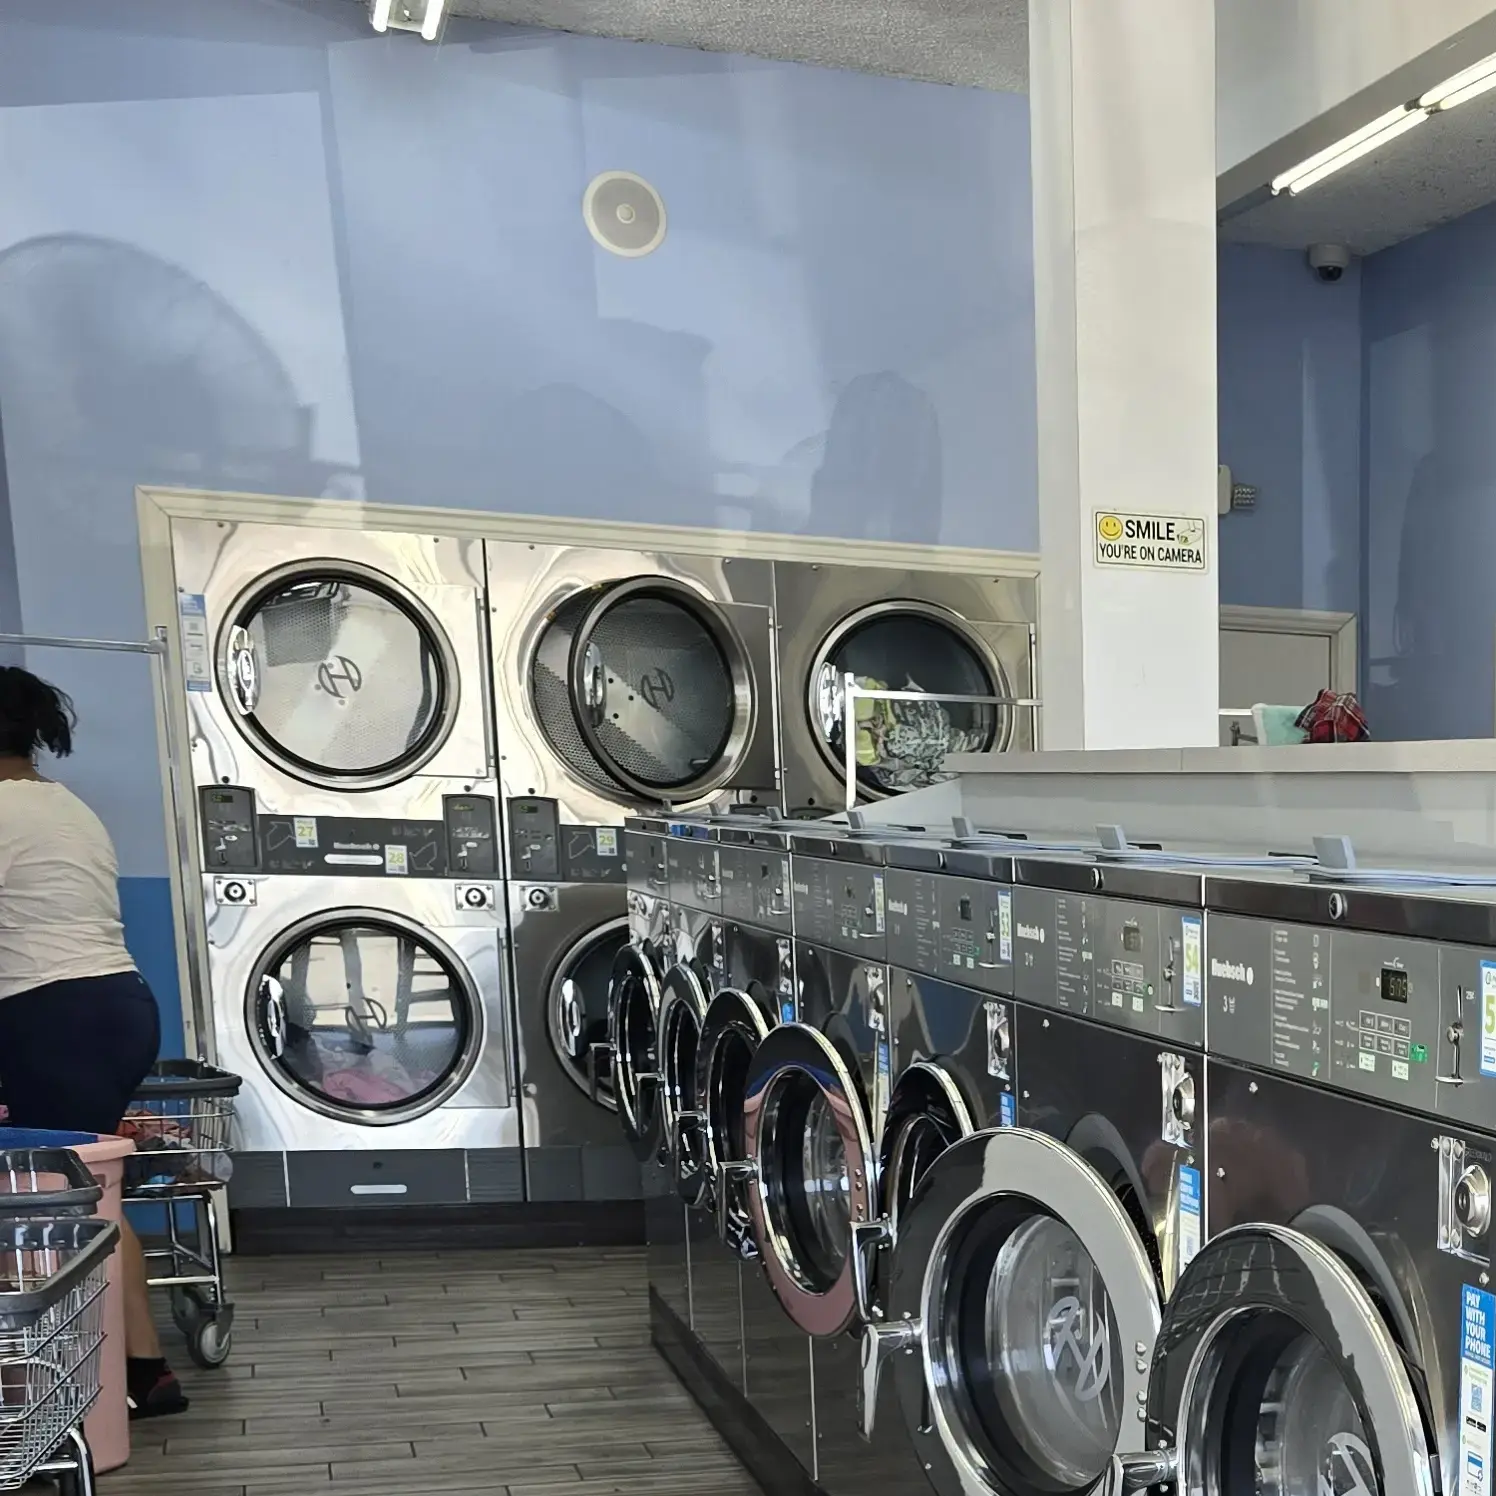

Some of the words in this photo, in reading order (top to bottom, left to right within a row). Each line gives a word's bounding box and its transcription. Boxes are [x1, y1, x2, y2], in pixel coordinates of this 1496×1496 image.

[1125, 519, 1175, 541] SMILE
[1099, 542, 1137, 560] YOU'RE
[1140, 546, 1155, 561] ON
[1157, 547, 1202, 563] CAMERA
[1465, 1305, 1486, 1326] WITH
[1465, 1320, 1486, 1342] YOUR
[1465, 1334, 1491, 1359] PHONE
